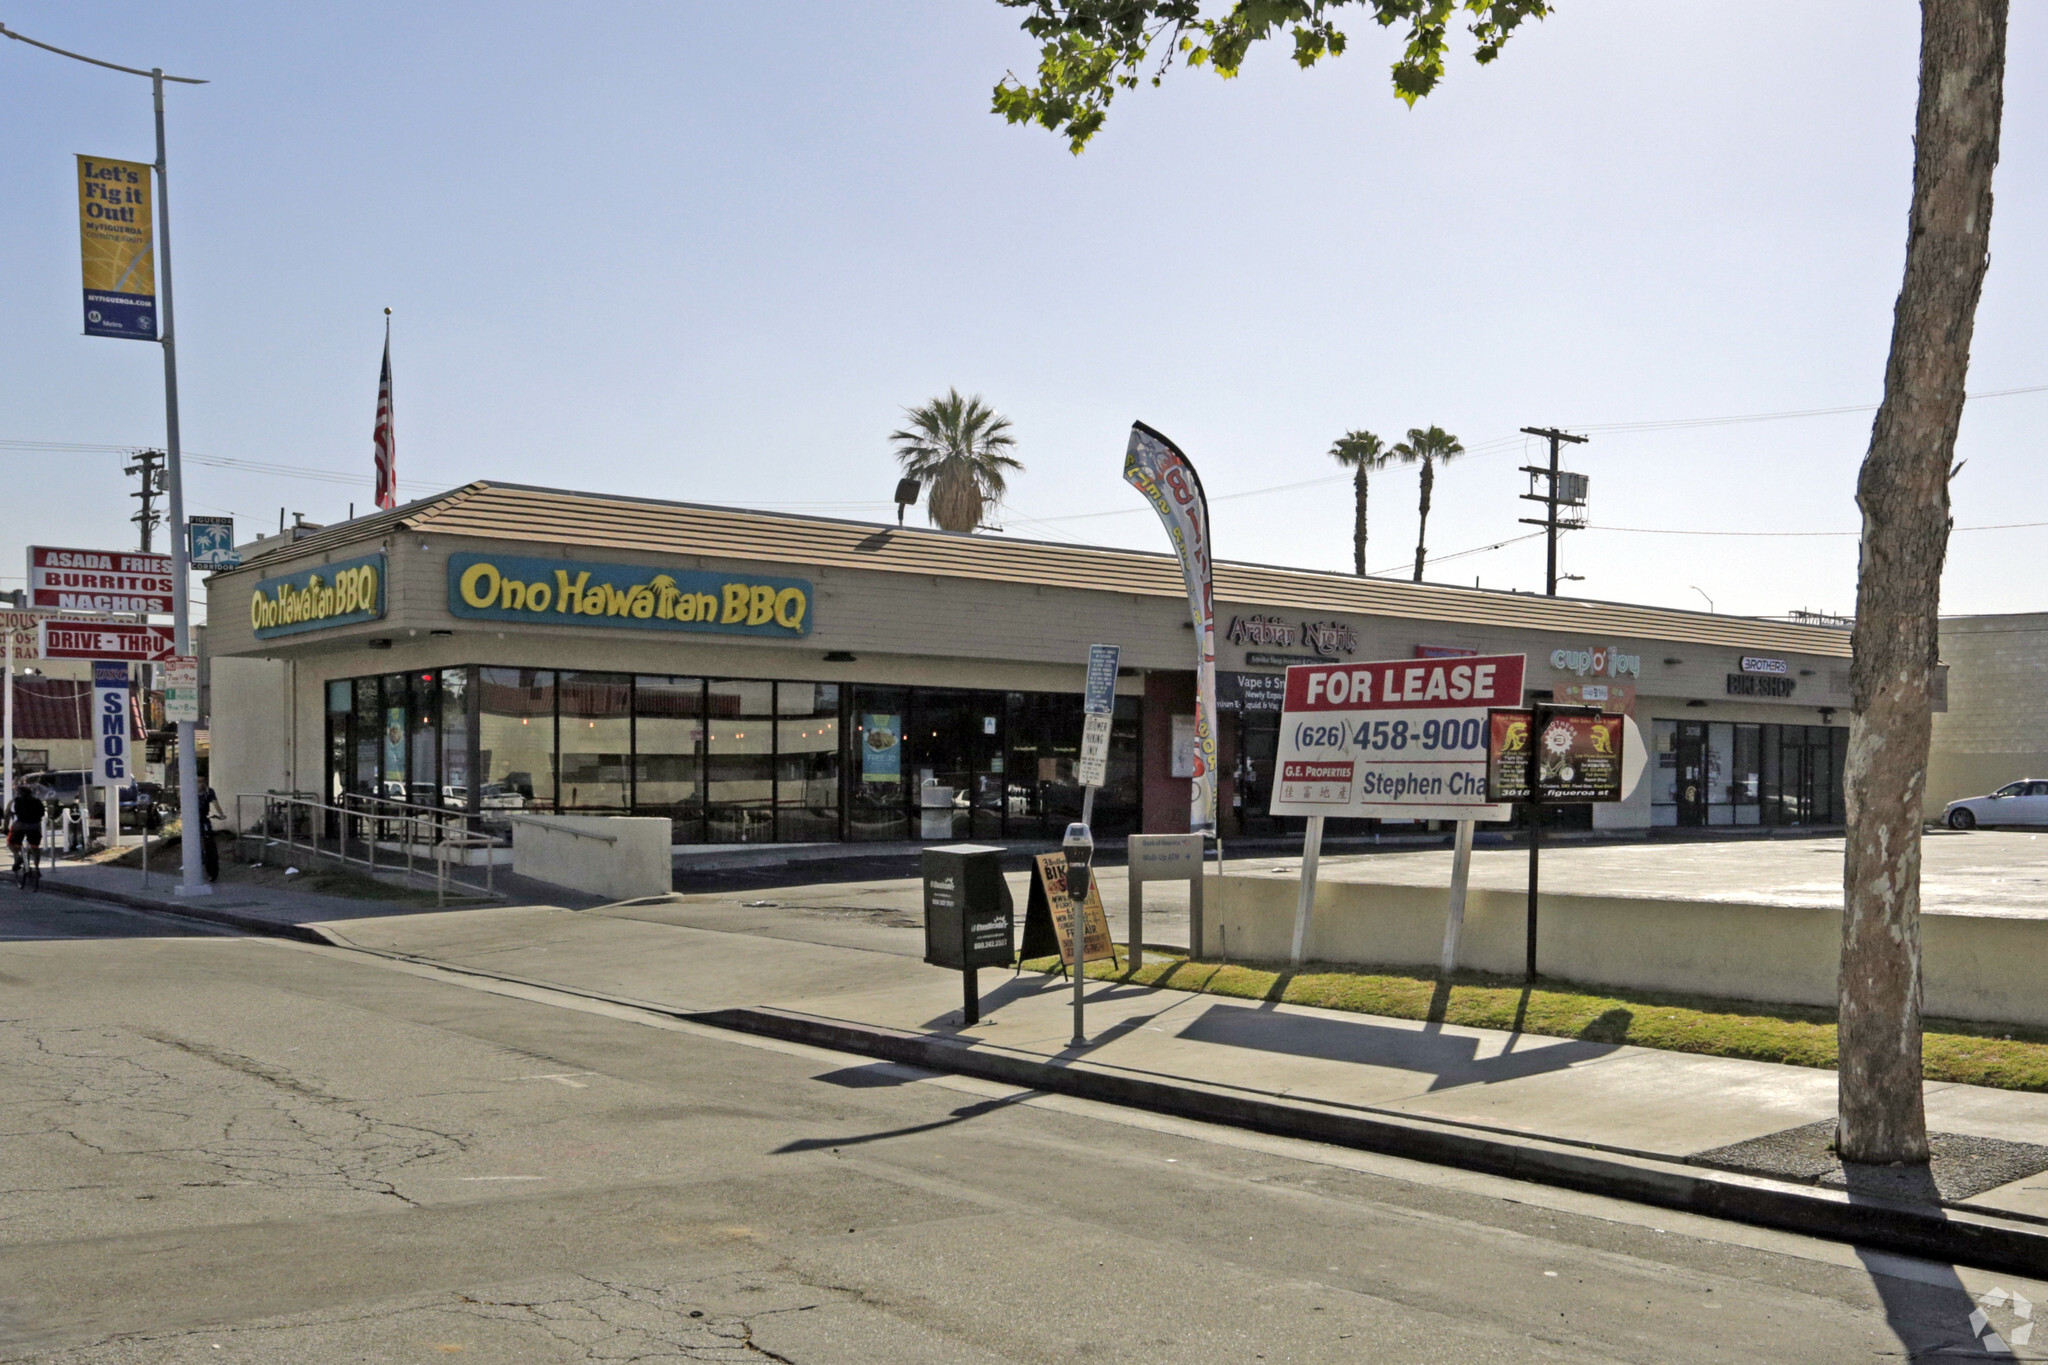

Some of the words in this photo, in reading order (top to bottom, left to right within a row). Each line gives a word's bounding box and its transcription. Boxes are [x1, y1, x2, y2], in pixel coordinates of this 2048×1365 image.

[84, 162, 138, 184] Let's
[85, 182, 121, 205] Fig
[126, 186, 142, 205] it
[86, 202, 134, 223] Out!
[88, 295, 152, 307] MYFIGUEROA.COM
[190, 516, 232, 524] FIGUEROA
[45, 552, 112, 570] ASADA
[120, 557, 172, 573] FRIES
[45, 572, 173, 592] BURRITOS
[59, 593, 164, 612] NACHOS
[252, 590, 278, 630] Ono
[278, 577, 334, 624] Hawaiian
[335, 565, 378, 615] BBQ
[460, 562, 551, 613] Ono
[555, 572, 718, 623] Hawaiian
[720, 583, 807, 633] BBQ
[48, 631, 102, 650] DRIVE
[117, 634, 164, 651] THRU
[1230, 615, 1298, 647] Arabian
[1305, 622, 1359, 656] Nights
[1552, 649, 1591, 677] cup
[1611, 647, 1639, 679] joy
[1237, 675, 1262, 690] Vape
[1265, 677, 1271, 688] &
[1306, 670, 1372, 704] FOR
[1382, 664, 1497, 702] LEASE
[1759, 675, 1796, 697] SHOP
[1245, 690, 1266, 700] Newly
[103, 692, 125, 778] SMOG
[1295, 721, 1346, 751] (626)
[1285, 766, 1303, 777] G.E.
[1363, 771, 1442, 799] Stephen
[1450, 772, 1486, 797] Cha
[1547, 789, 1595, 797] figueroa
[1045, 866, 1067, 881] BIK
[1085, 925, 1097, 935] AIR
